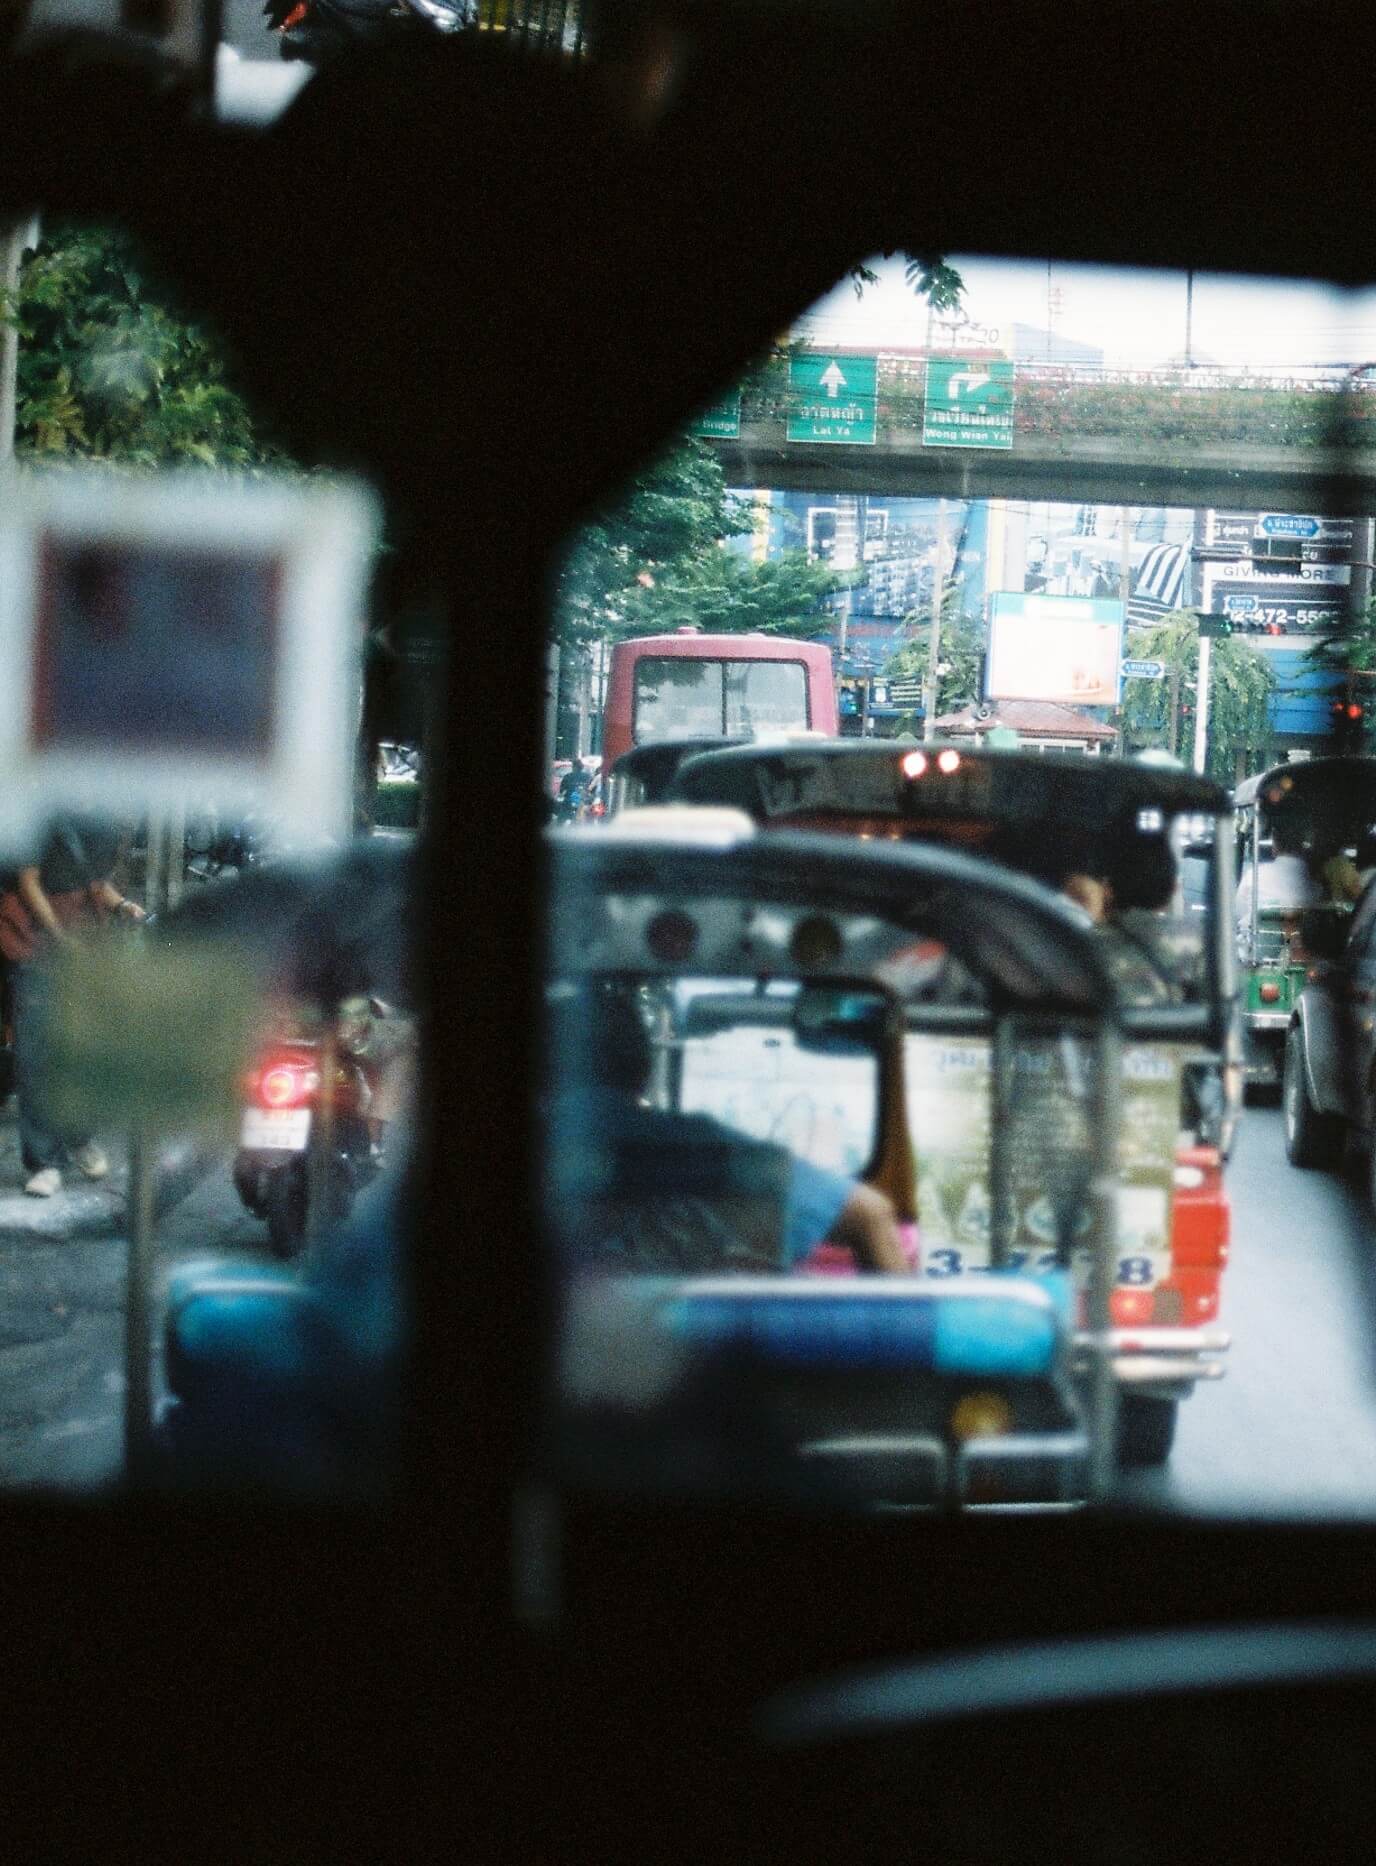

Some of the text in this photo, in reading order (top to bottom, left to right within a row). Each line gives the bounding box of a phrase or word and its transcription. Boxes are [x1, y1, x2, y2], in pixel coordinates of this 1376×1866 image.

[813, 425, 851, 436] Lat Ya
[926, 428, 1010, 441] Wong Wian Yai
[1229, 608, 1340, 626] 2-472-55
